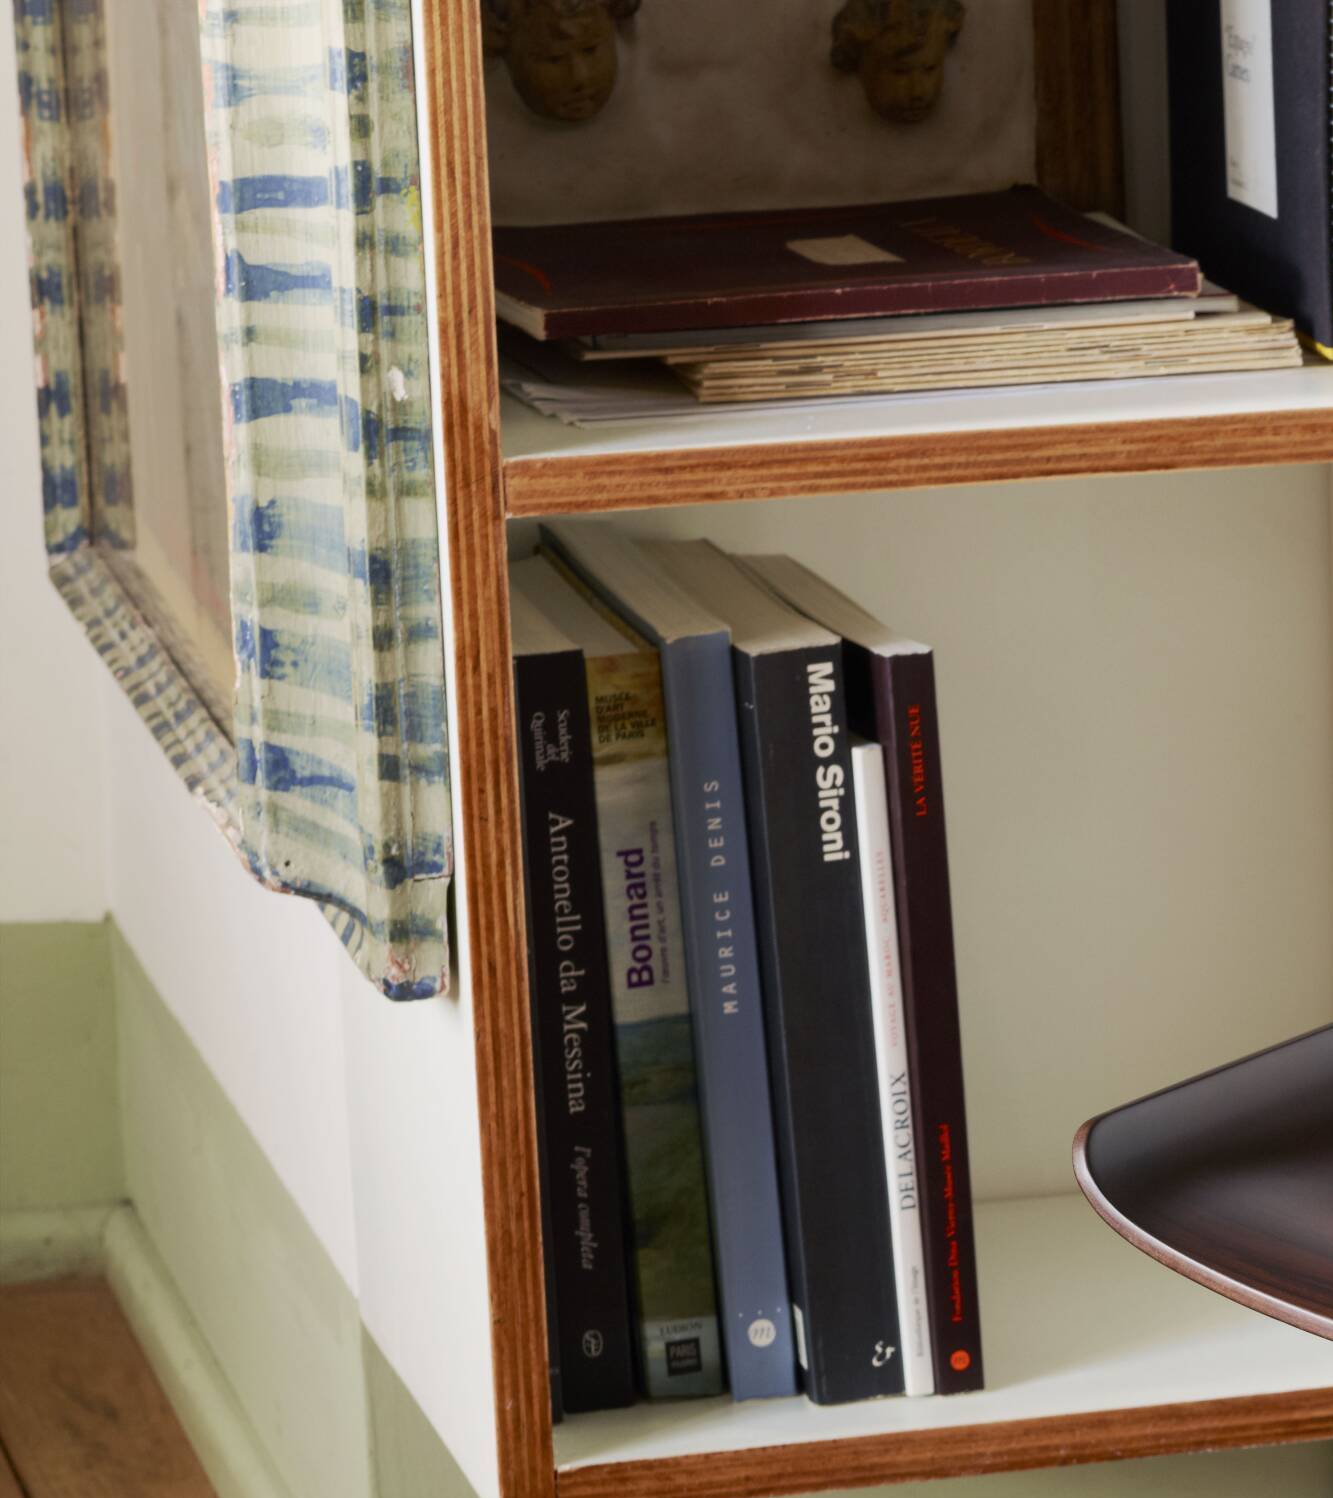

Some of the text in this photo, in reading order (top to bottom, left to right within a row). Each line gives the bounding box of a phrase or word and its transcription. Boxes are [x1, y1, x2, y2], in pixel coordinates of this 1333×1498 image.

[531, 711, 546, 773] Quirinale
[615, 729, 645, 742] PARIS
[806, 660, 852, 864] Mario Sironi
[905, 704, 927, 817] LA VÉRITÉ NUE
[547, 811, 592, 1115] Antonello da Messina
[625, 846, 655, 991] Bonnard
[703, 779, 738, 1016] MAURICE DENIS
[889, 1070, 917, 1212] DELACROIX
[669, 1342, 697, 1360] PARIS
